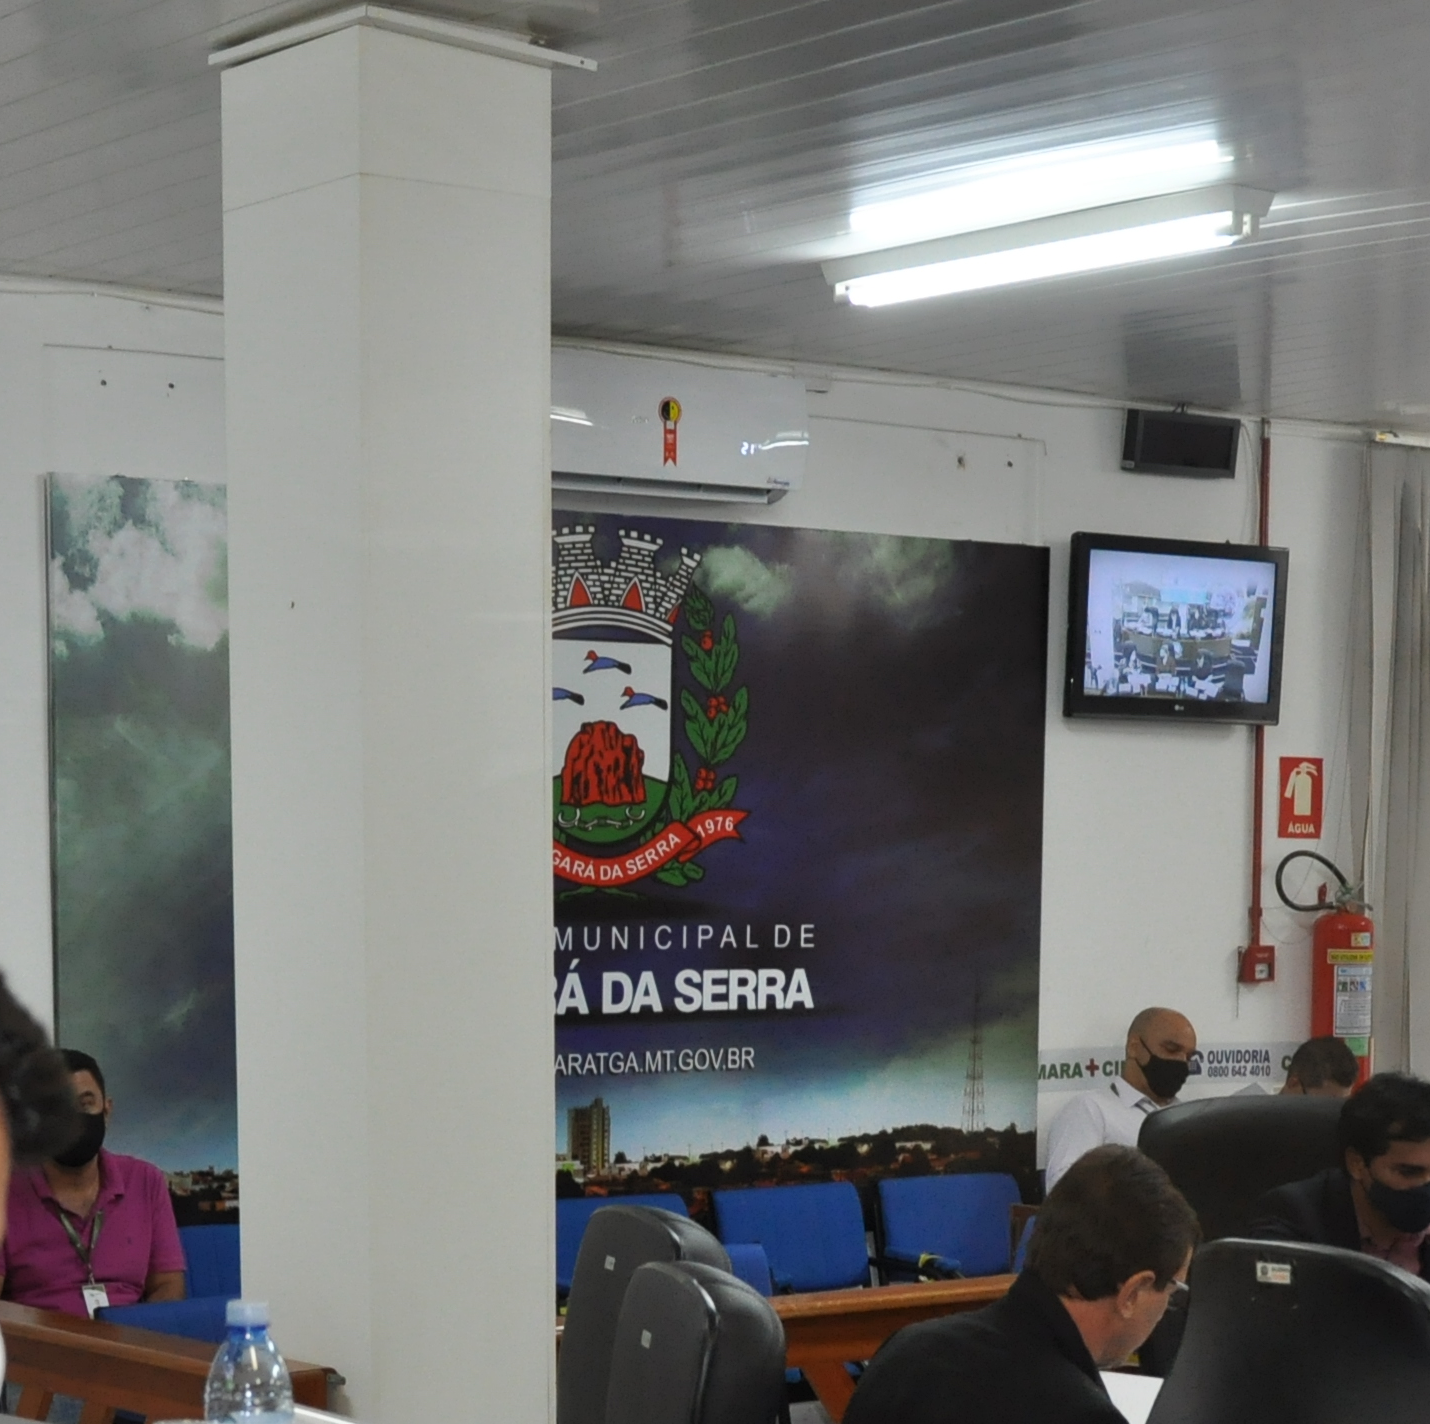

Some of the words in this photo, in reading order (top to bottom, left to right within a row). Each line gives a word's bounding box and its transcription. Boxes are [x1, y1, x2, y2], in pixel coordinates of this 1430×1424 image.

[695, 815, 735, 839] 1976
[1287, 820, 1316, 834] ÁGUA
[599, 864, 624, 881] DA
[625, 831, 681, 876] SERRA
[554, 924, 759, 951] MUNICIPAL
[773, 923, 816, 949] DE
[601, 970, 664, 1015] DA
[673, 967, 815, 1013] SERRA
[1207, 1049, 1271, 1065] OUVIDORIA
[1207, 1065, 1230, 1078] 0800
[1231, 1065, 1249, 1077] 642
[1249, 1064, 1271, 1077] 4010
